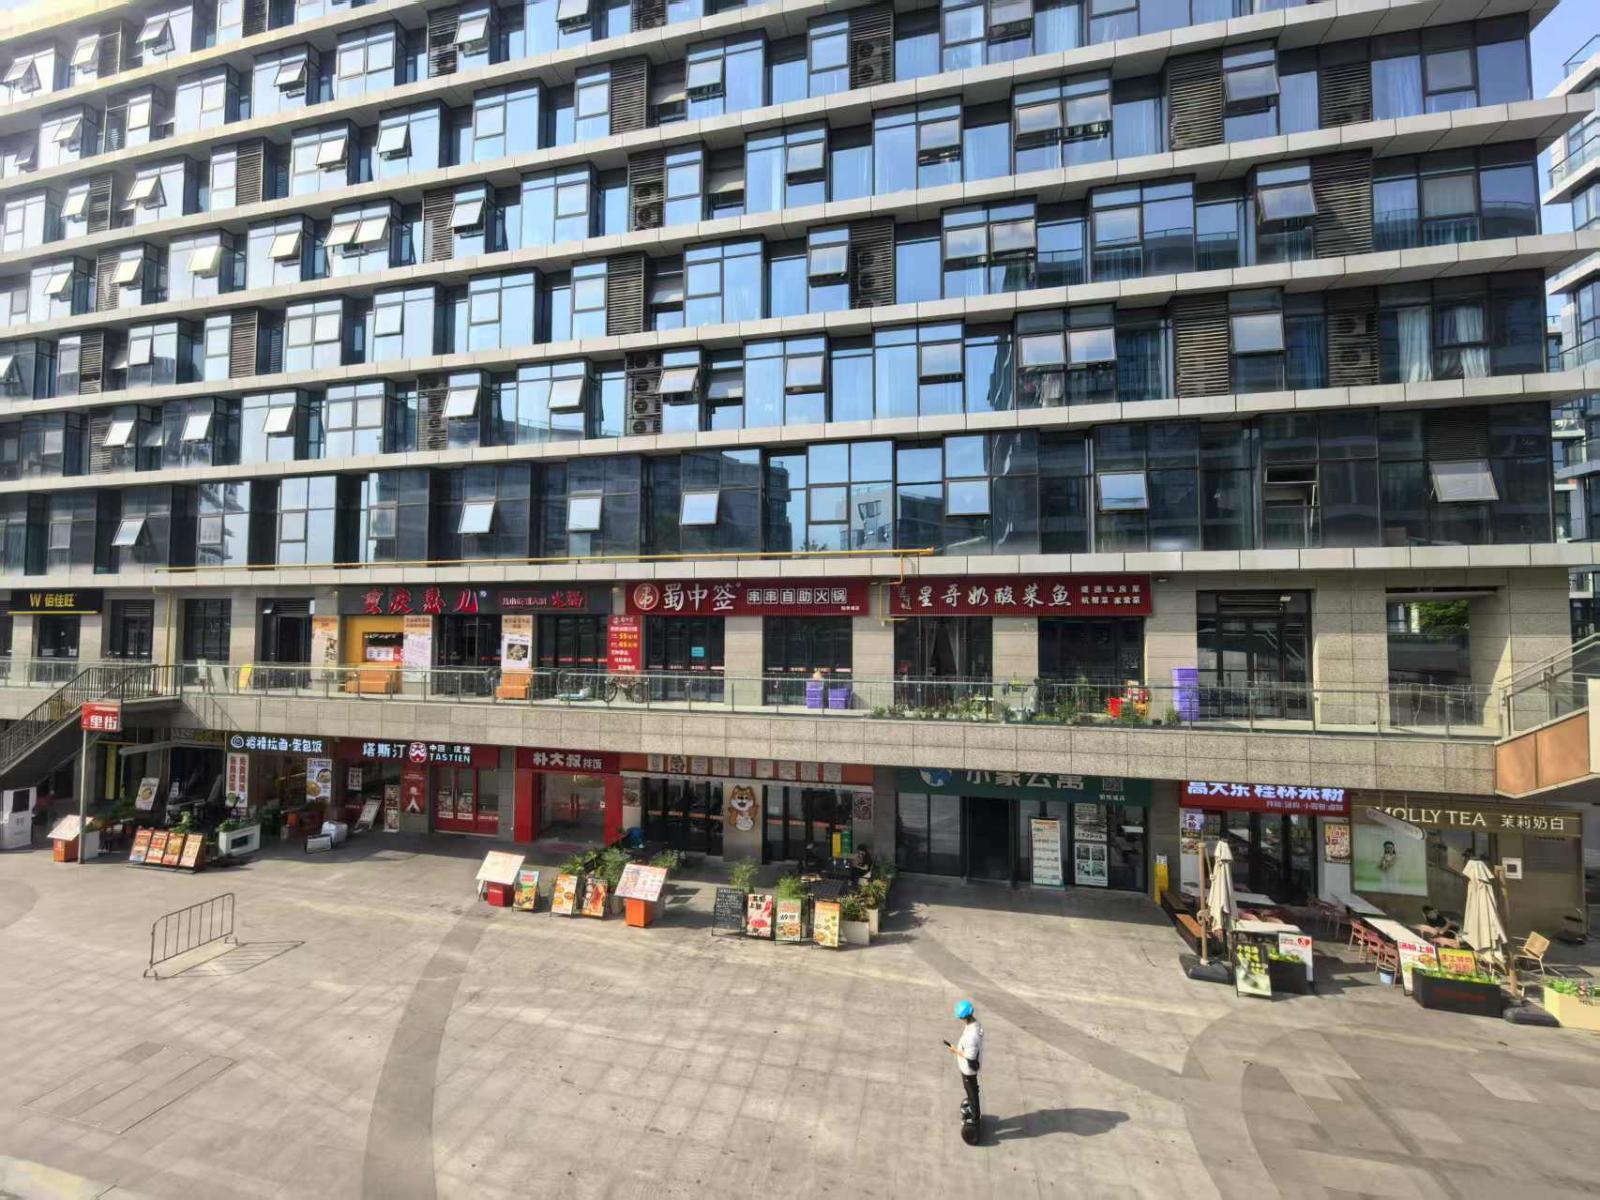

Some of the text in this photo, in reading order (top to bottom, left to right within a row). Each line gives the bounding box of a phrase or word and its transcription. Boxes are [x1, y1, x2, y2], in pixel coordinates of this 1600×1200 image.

[663, 582, 848, 612] 蜀中签 串串自助火锅
[363, 742, 406, 759] 塔斯汀
[429, 752, 471, 764] TASTIEN
[1444, 810, 1487, 827] TEA
[1500, 814, 1565, 831] 茉莉奶白
